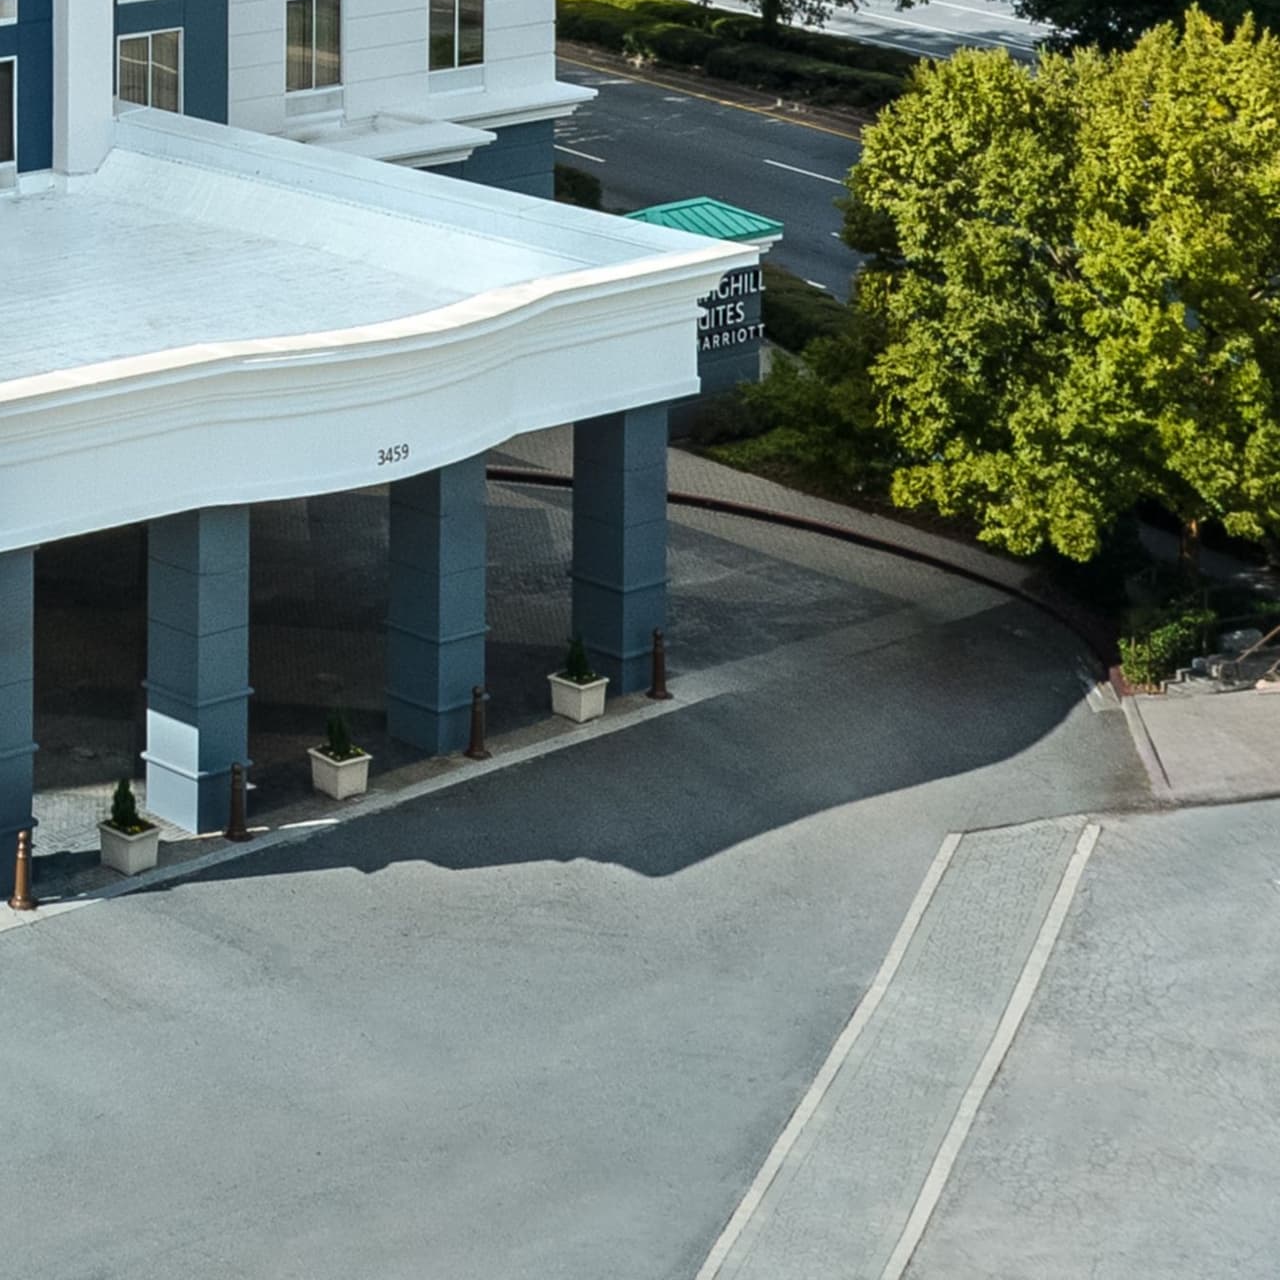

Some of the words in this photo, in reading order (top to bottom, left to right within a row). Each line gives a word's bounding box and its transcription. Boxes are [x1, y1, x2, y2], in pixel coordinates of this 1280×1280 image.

[698, 301, 745, 330] UITES
[697, 323, 765, 352] ARRIOTT
[377, 443, 409, 466] 3459
